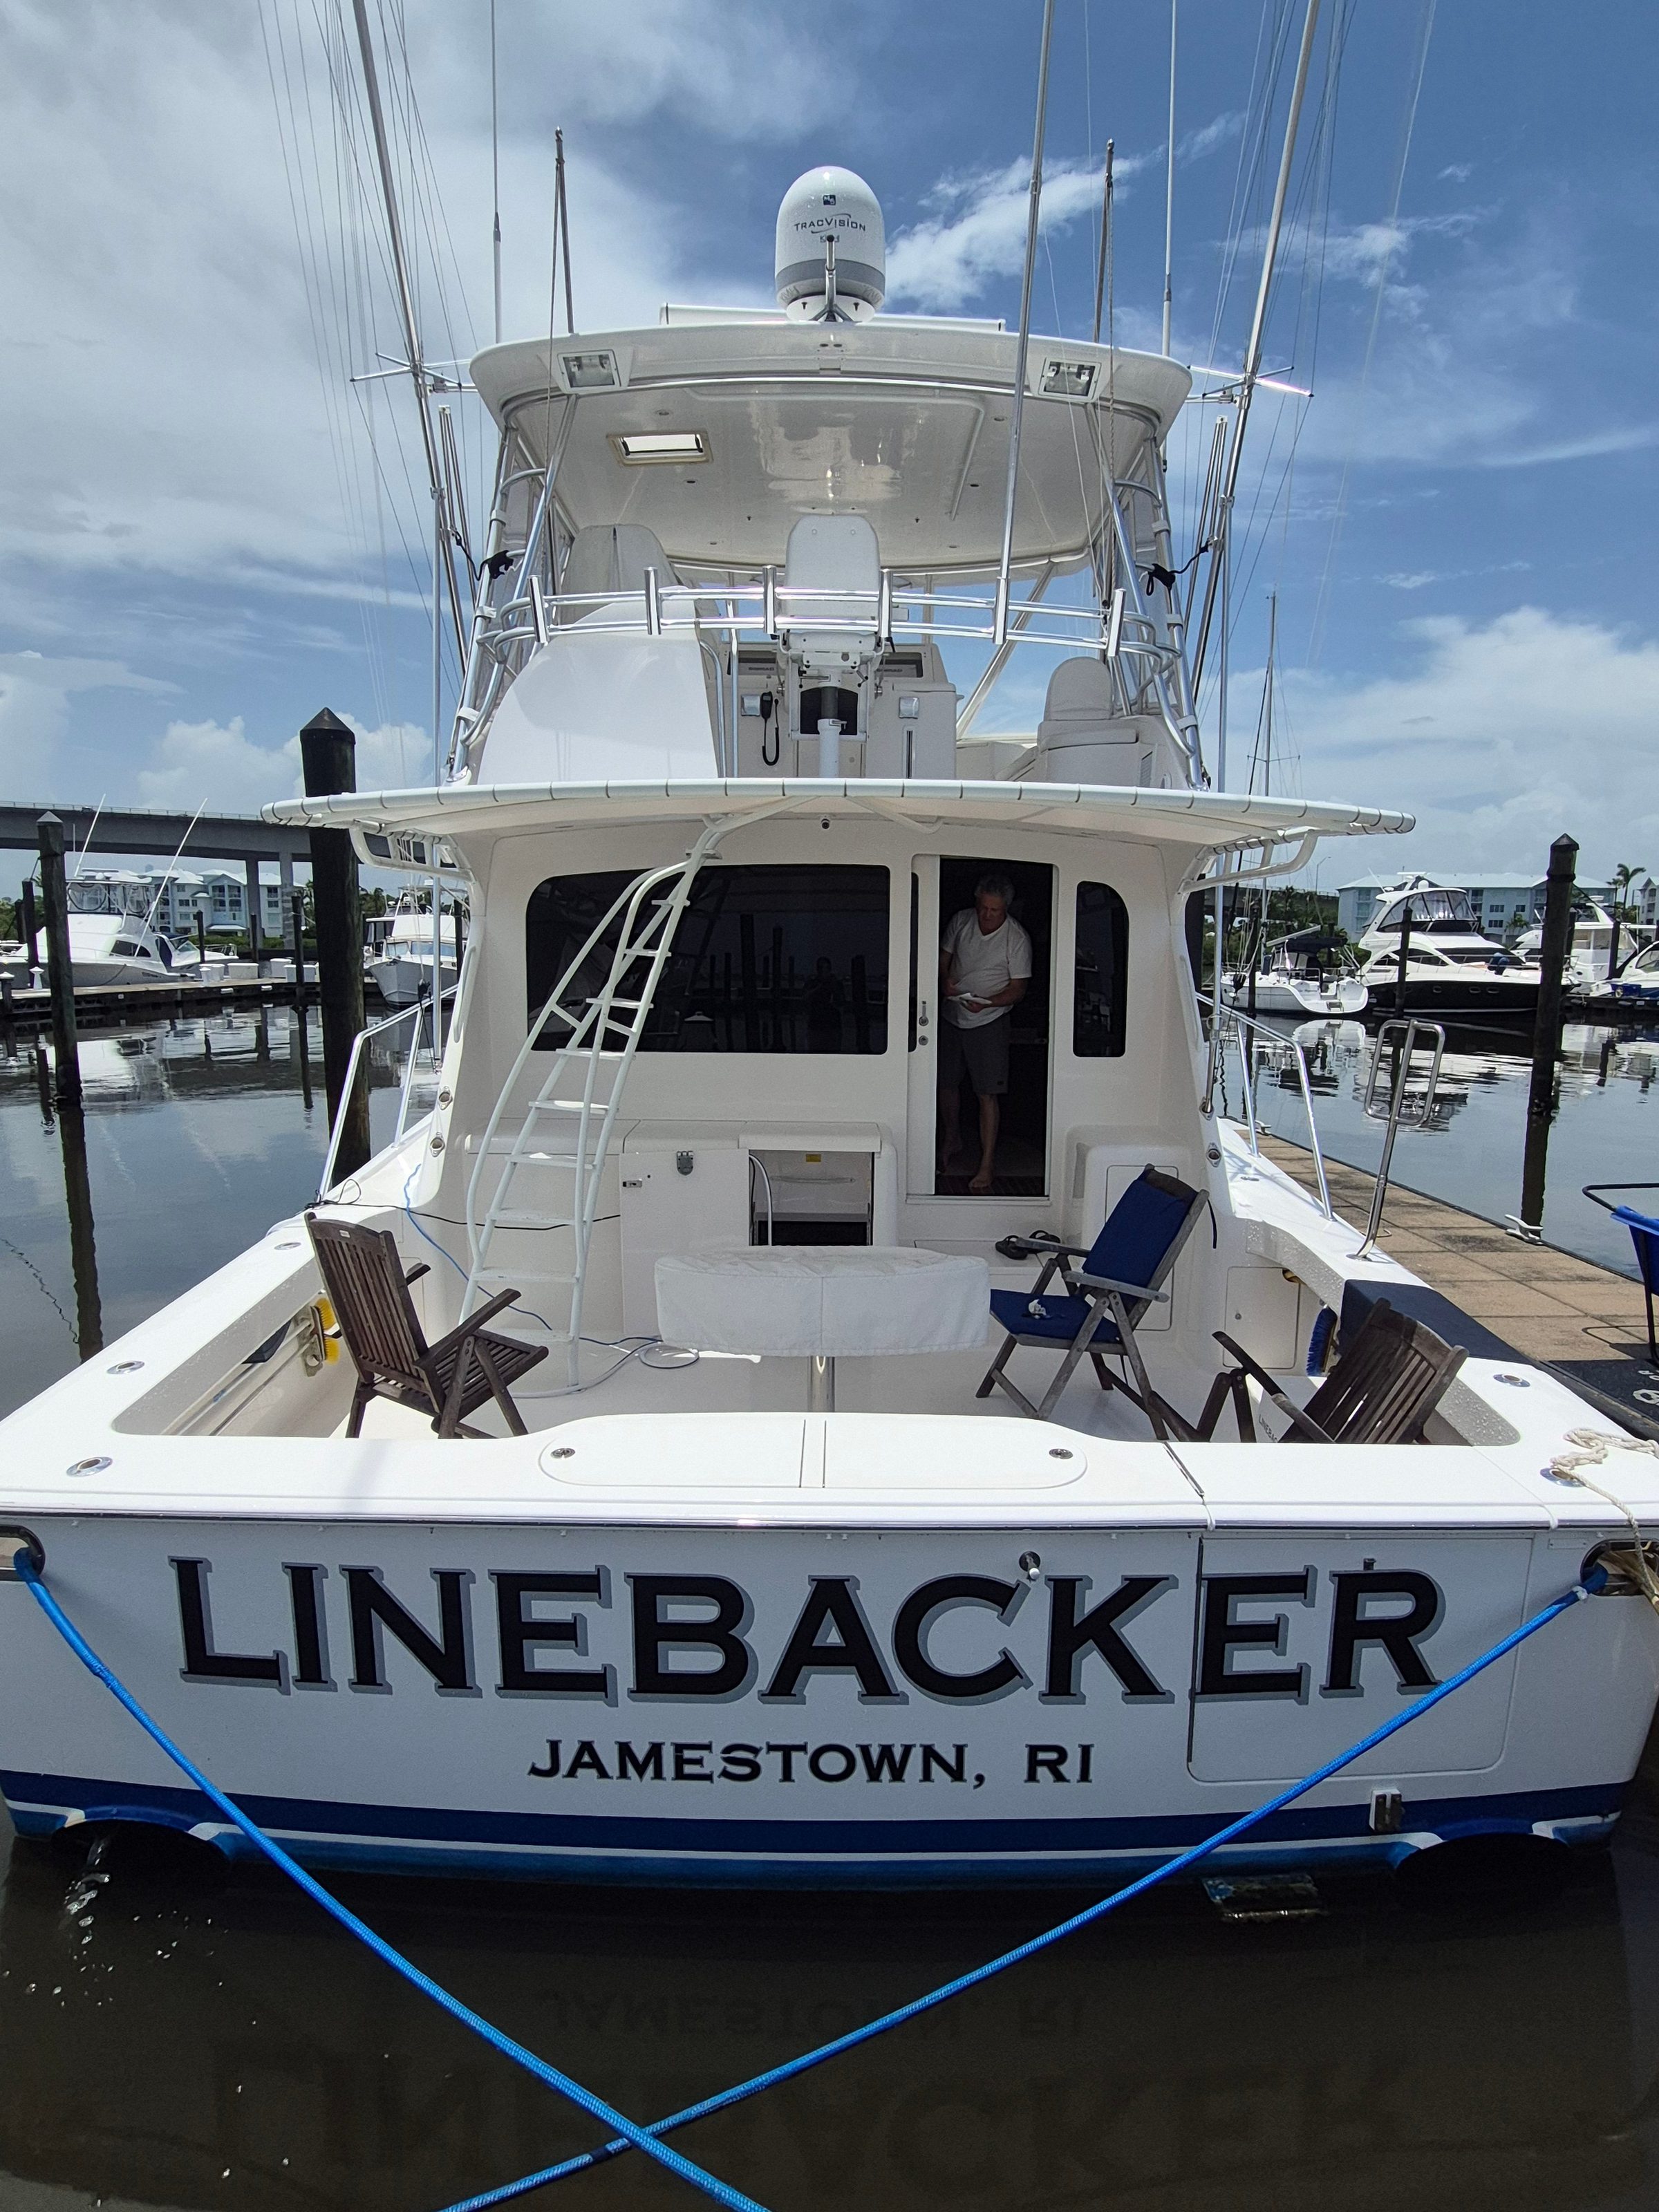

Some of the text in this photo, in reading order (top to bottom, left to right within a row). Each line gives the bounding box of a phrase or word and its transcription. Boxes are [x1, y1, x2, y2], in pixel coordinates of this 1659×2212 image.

[167, 1555, 1446, 1707] LINEBACKER
[527, 1739, 1095, 1789] JAMESTOWN, RI
